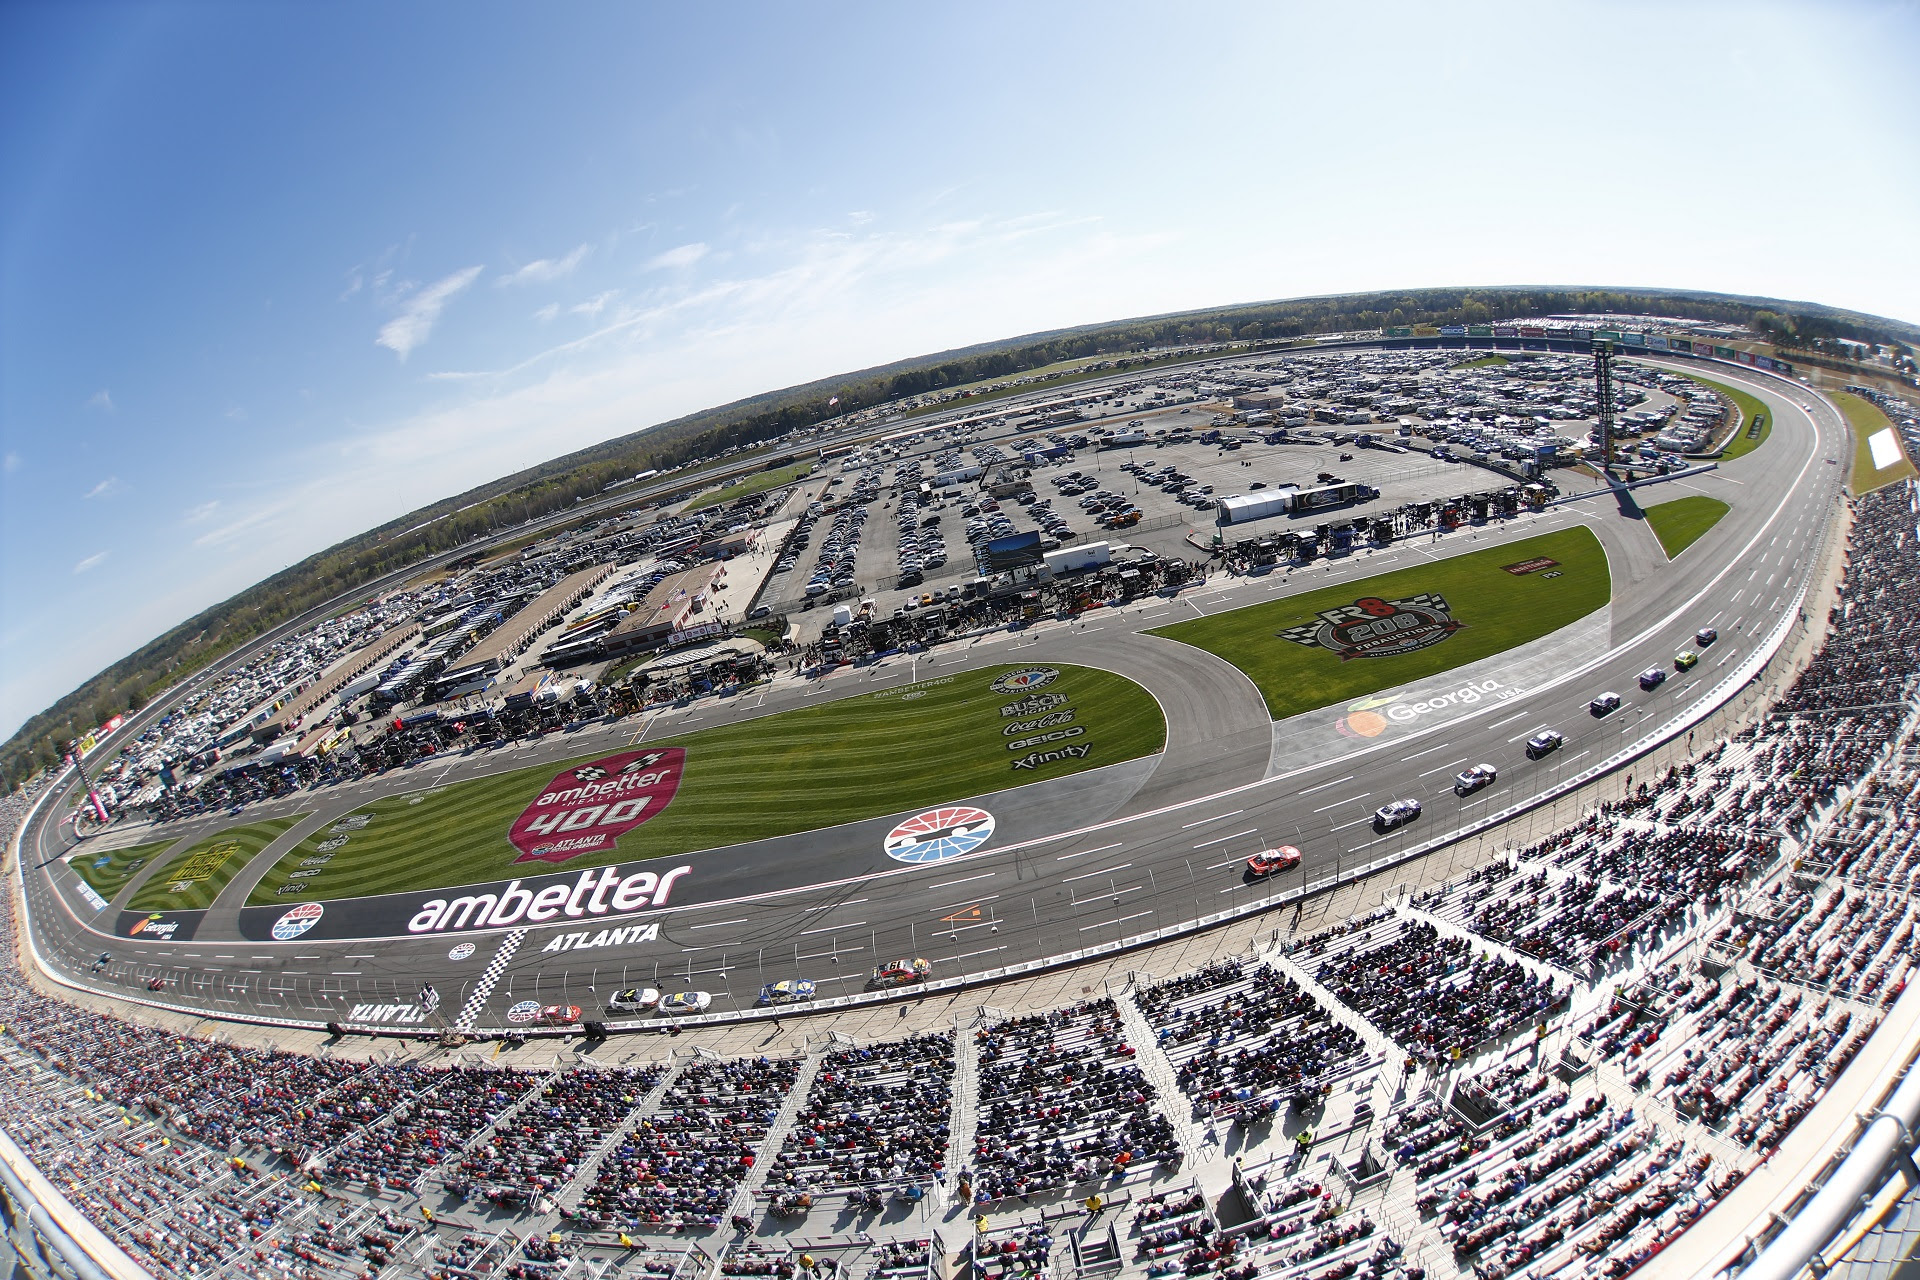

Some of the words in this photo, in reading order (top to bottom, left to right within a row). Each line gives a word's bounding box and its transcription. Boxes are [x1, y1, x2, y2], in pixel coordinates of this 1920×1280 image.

[1321, 598, 1396, 625] FR8
[1347, 612, 1420, 643] 208
[1001, 693, 1068, 717] BUSCH
[1387, 679, 1504, 720] Georgia
[1496, 687, 1526, 700] USA
[1003, 708, 1077, 736] Coca-Cola
[1017, 704, 1054, 717] LIGHT
[1009, 727, 1085, 749] GEICO
[1014, 744, 1090, 770] xfinity
[537, 769, 671, 806] ambetter
[567, 791, 625, 807] HEALTH
[524, 796, 653, 836] 400
[555, 834, 607, 849] ATLANTA
[175, 863, 223, 879] TOUGH
[407, 865, 692, 933] ambetter
[143, 921, 179, 935] Georgia
[541, 923, 660, 952] ATLANTA
